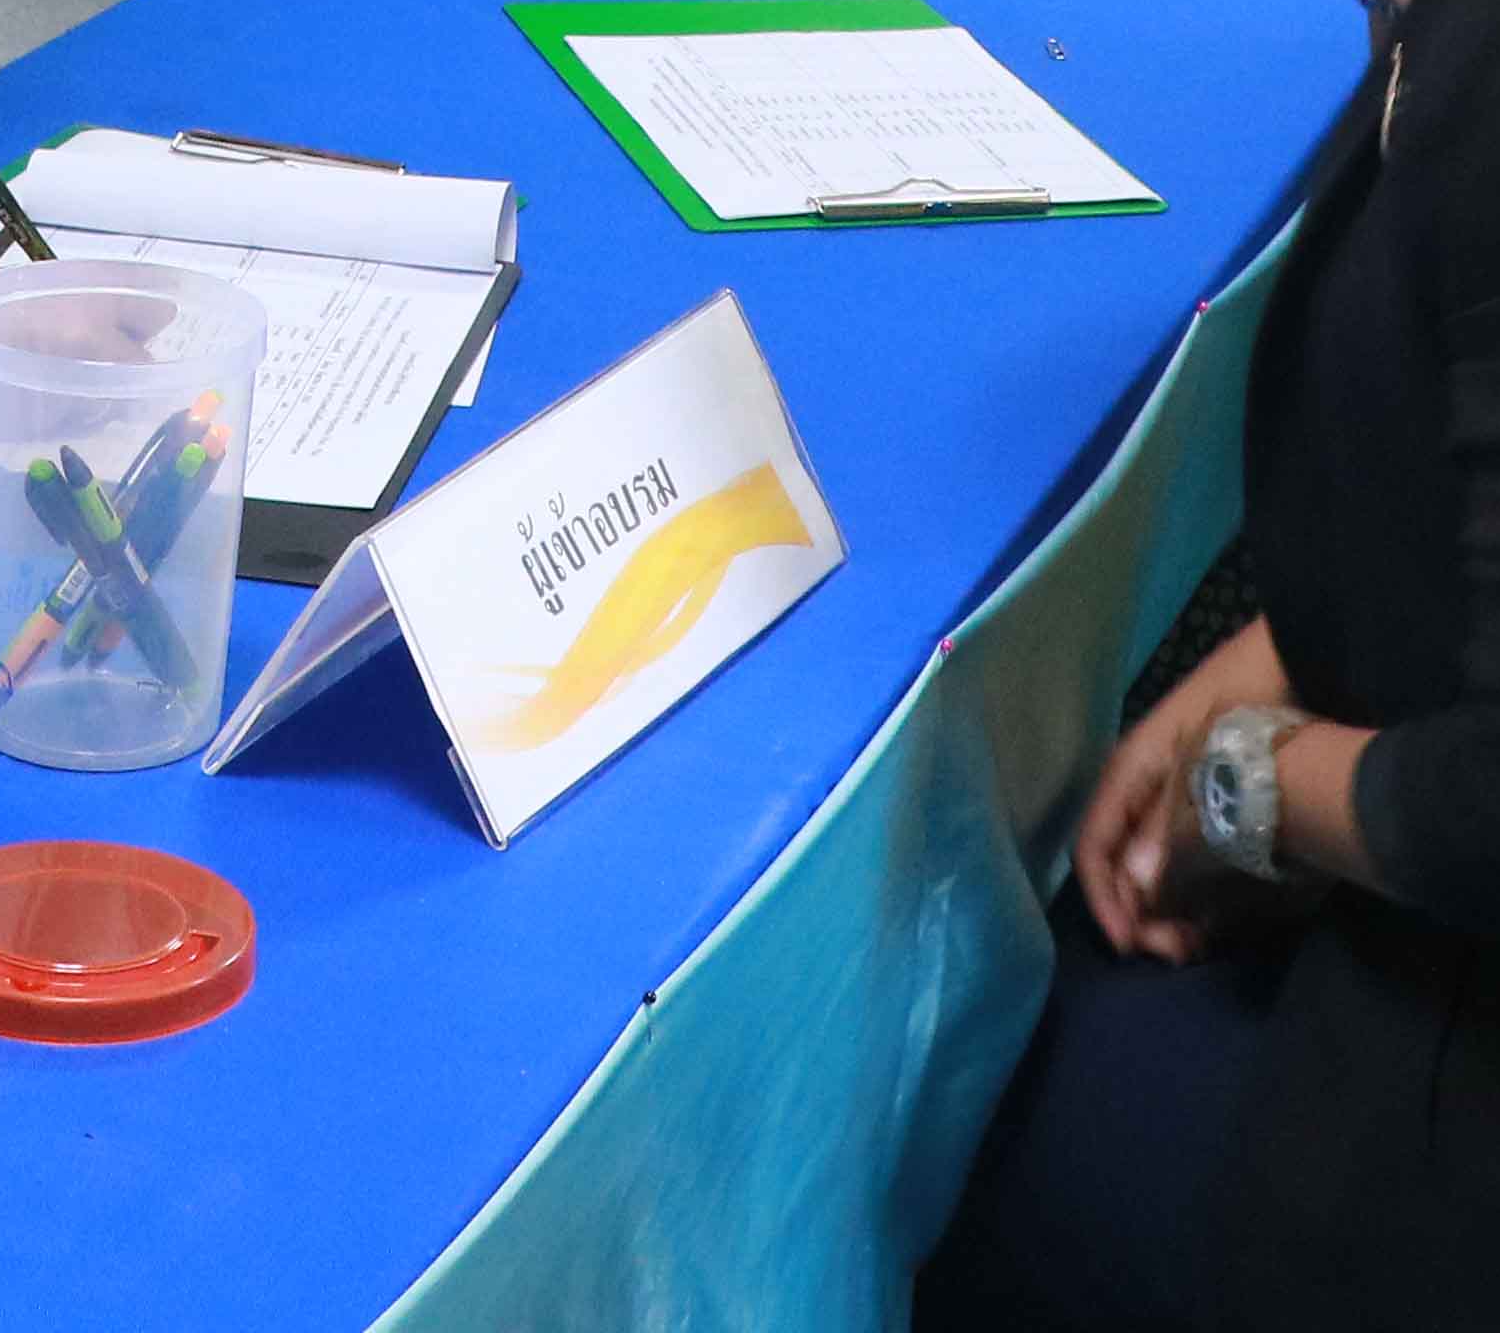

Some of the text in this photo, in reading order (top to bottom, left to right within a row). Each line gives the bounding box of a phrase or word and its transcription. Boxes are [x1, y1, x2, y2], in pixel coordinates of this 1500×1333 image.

[516, 457, 679, 616] ผู้เข้าอบรม
